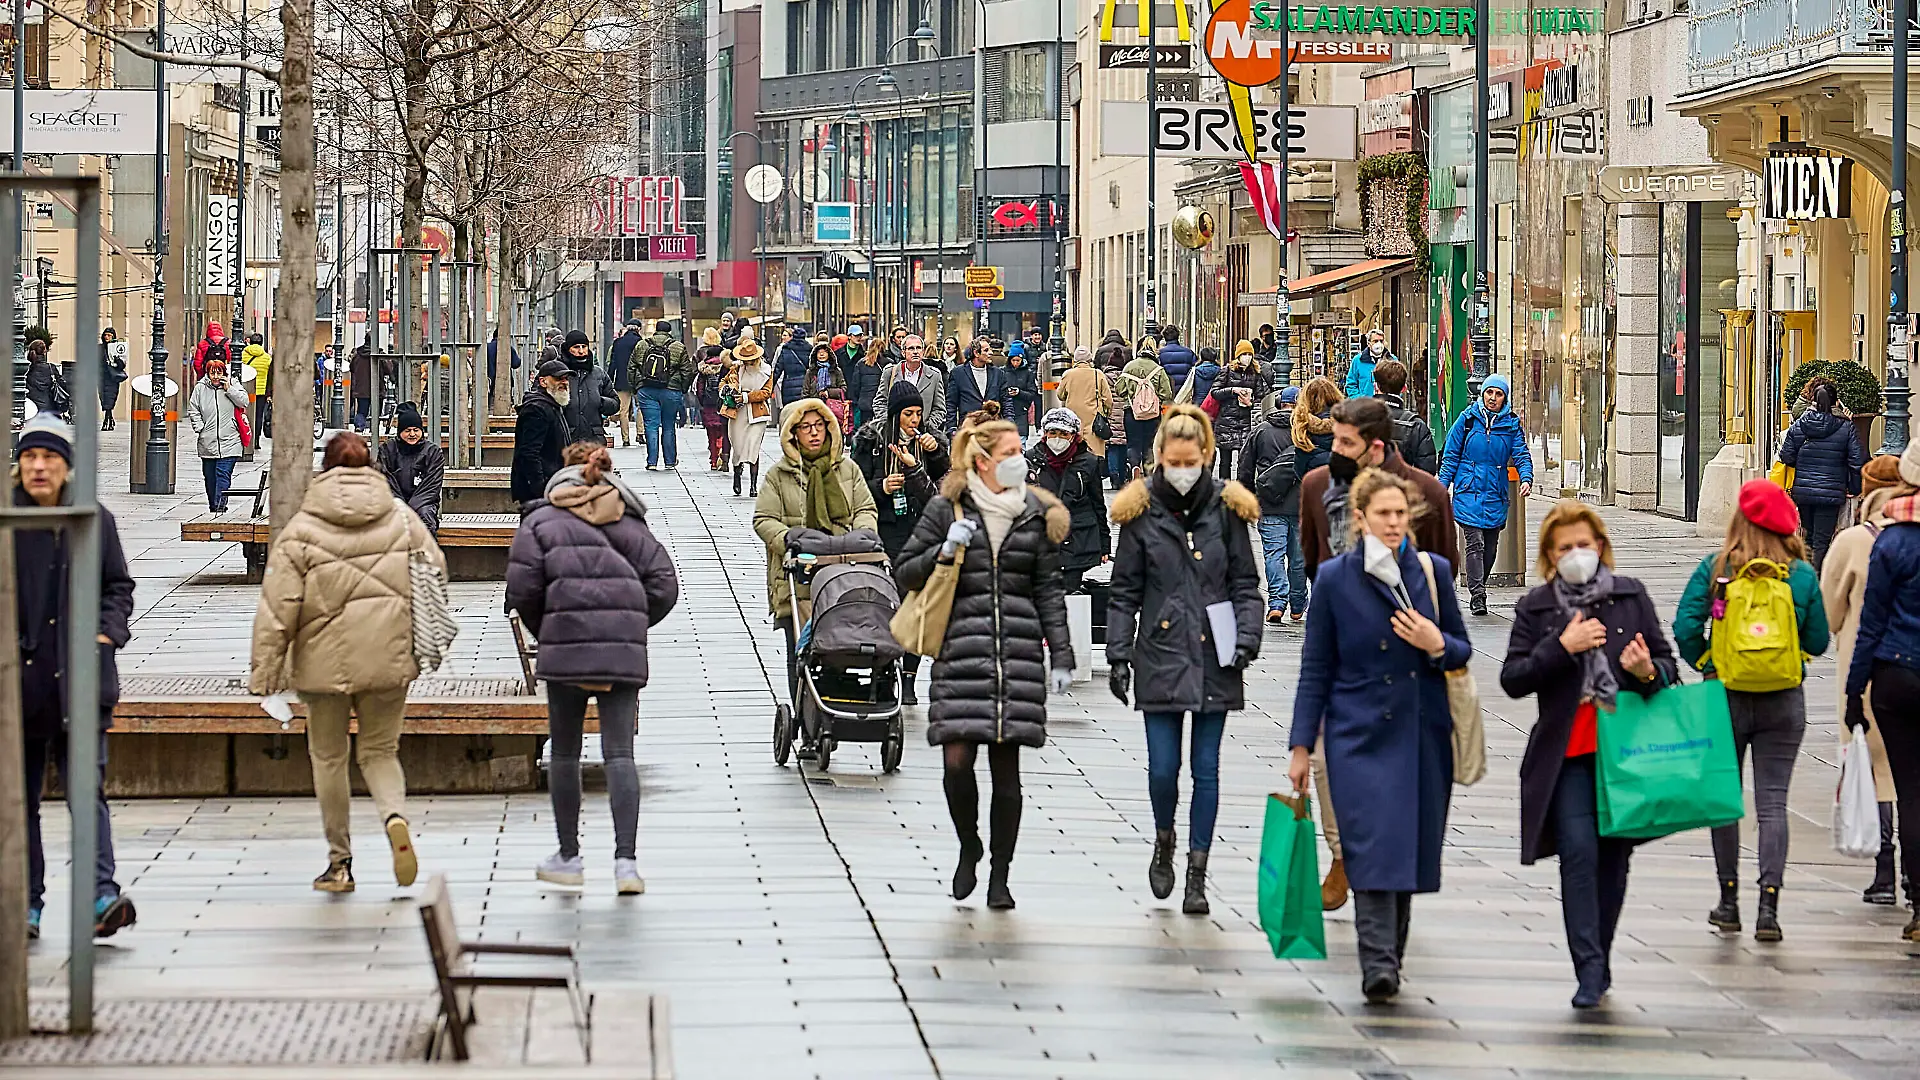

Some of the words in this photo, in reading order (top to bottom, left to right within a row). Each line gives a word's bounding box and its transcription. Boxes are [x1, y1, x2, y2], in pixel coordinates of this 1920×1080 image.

[1253, 2, 1477, 36] SALAMANDER
[1300, 42, 1391, 57] FESSLER
[29, 112, 121, 126] SEACRET
[1155, 107, 1307, 153] BREE
[1619, 176, 1726, 193] WEMPE
[1769, 157, 1843, 219] WIEN
[590, 176, 685, 234] STEFFL
[817, 216, 850, 224] AMERICAN
[208, 201, 223, 287] MANGO
[227, 205, 238, 288] MANGO
[658, 237, 687, 253] STEFFL
